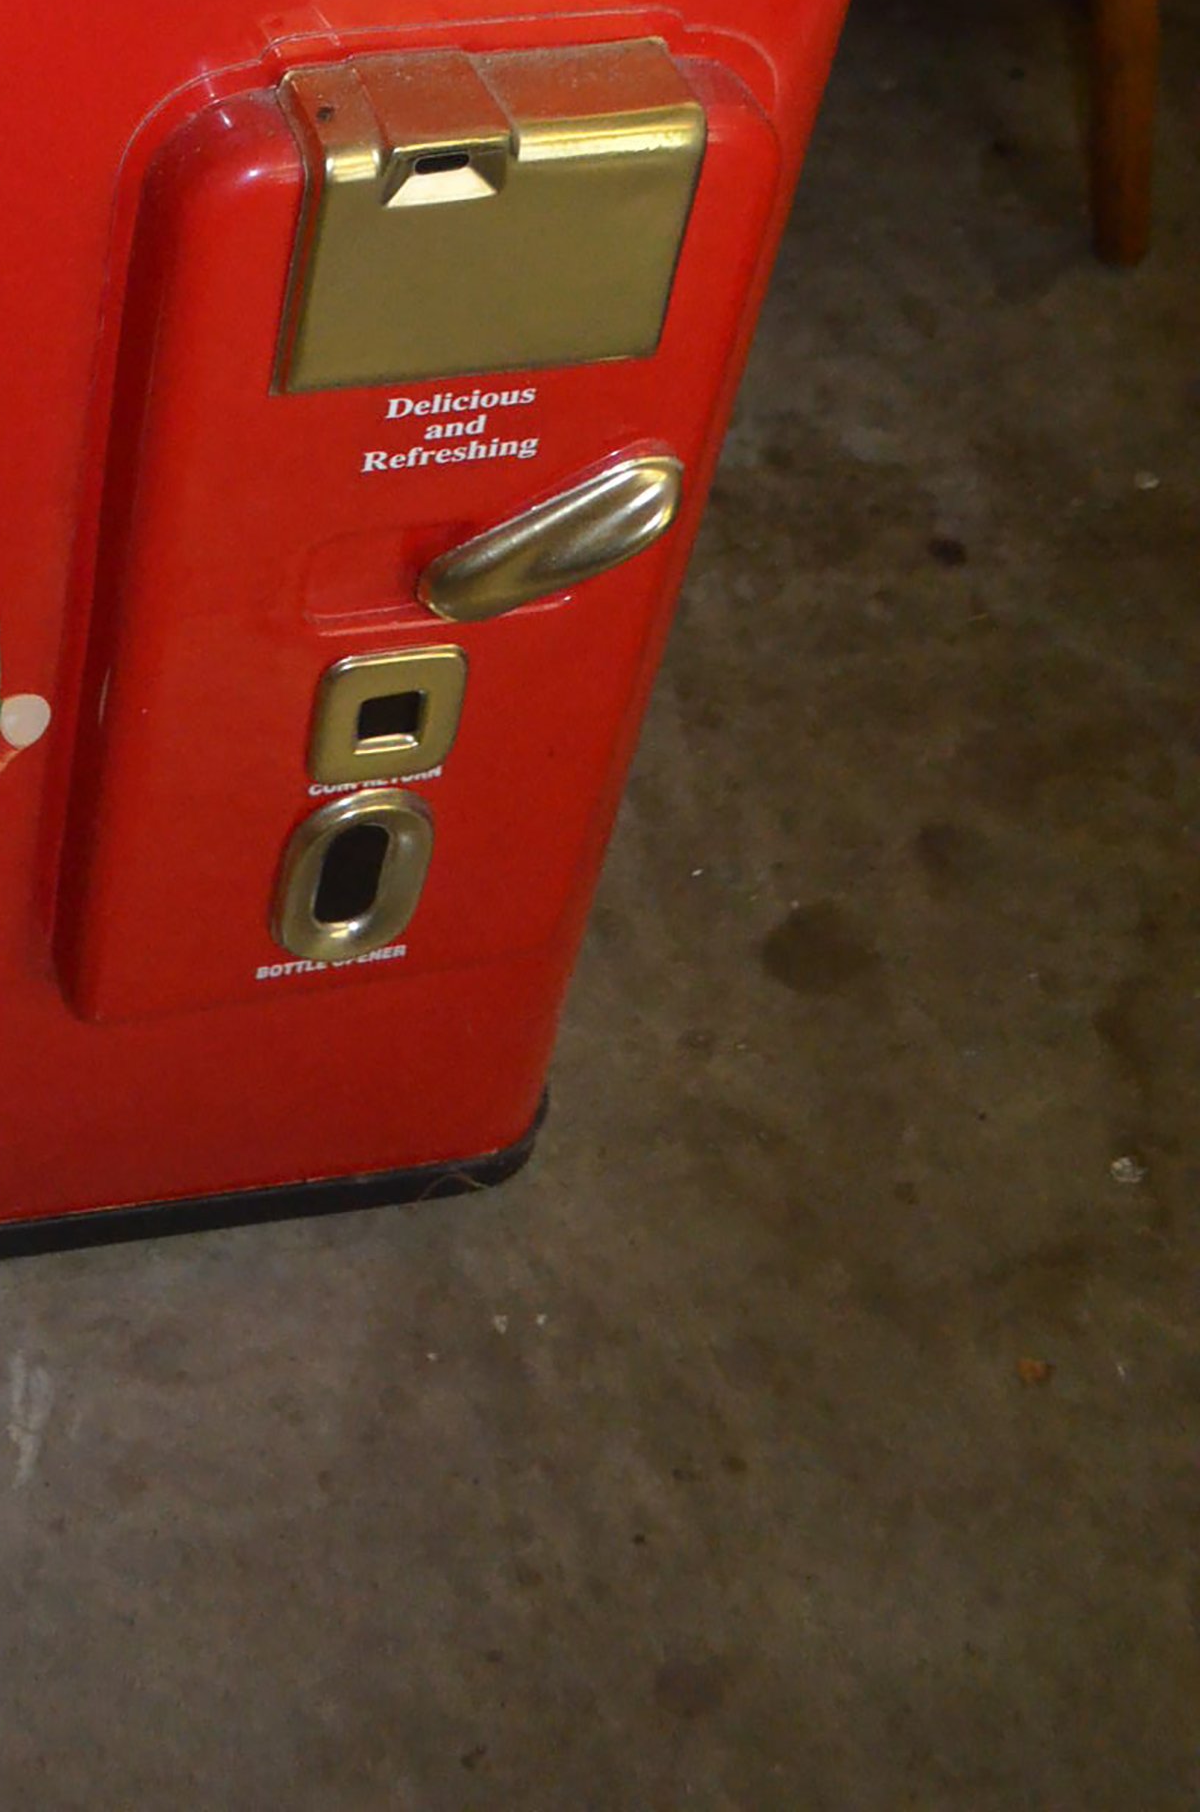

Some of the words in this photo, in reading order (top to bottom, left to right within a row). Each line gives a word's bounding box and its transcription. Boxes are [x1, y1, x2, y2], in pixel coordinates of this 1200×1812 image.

[385, 387, 537, 419] Delicious
[424, 414, 487, 440] and
[361, 437, 539, 473] Refreshing
[255, 959, 327, 980] BOTTLE
